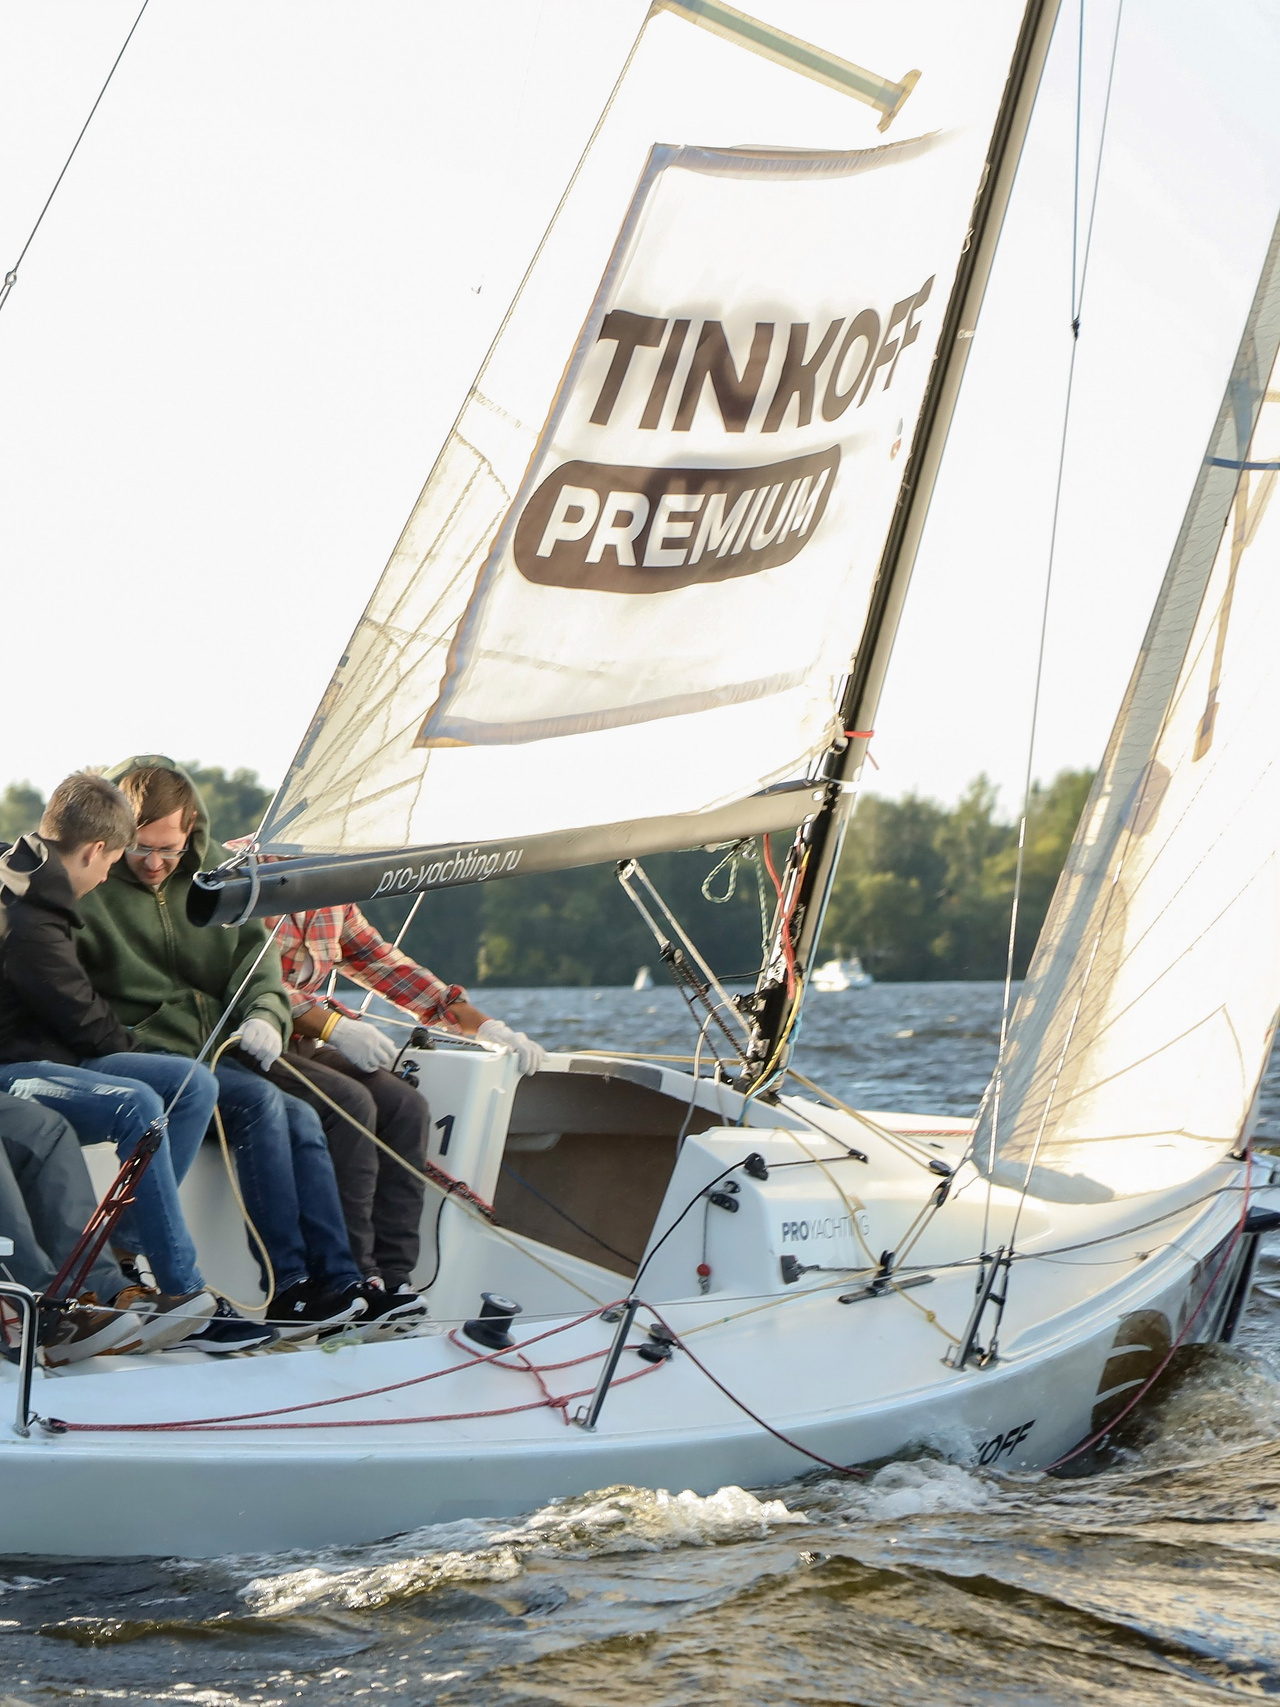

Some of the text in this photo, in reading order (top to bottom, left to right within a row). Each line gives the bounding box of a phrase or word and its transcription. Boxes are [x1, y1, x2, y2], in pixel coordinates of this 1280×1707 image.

[588, 274, 936, 434] TINKOFF
[535, 467, 832, 568] PREMIUM
[369, 848, 524, 900] pro-yachting.ru
[434, 1114, 455, 1156] 1
